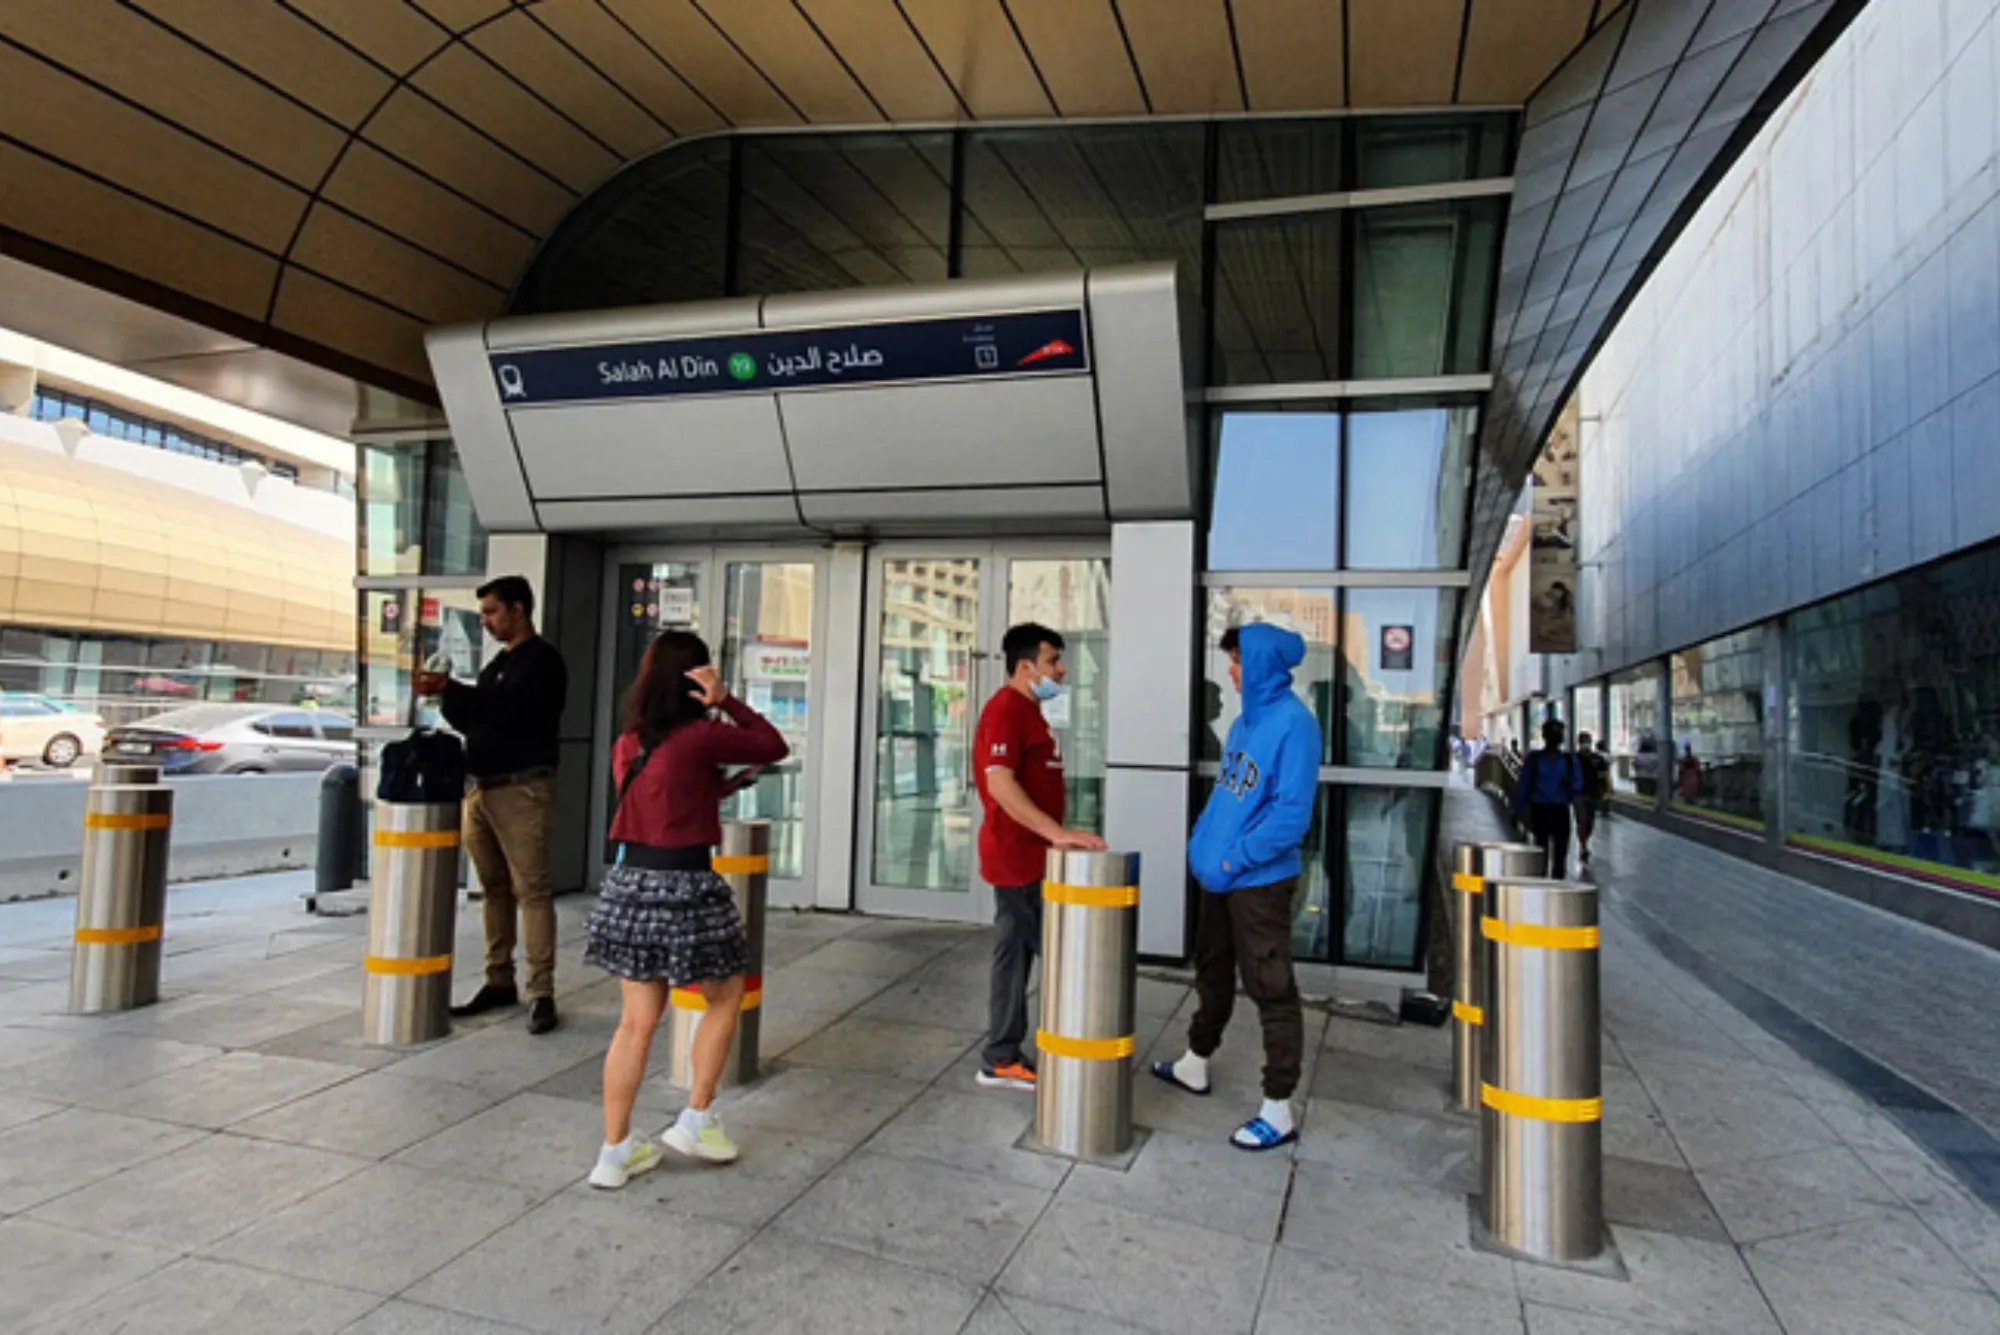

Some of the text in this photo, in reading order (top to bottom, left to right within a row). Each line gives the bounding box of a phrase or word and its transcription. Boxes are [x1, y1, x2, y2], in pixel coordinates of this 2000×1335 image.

[598, 355, 719, 385] Salah Al Din
[767, 343, 883, 376] صلاح الدين
